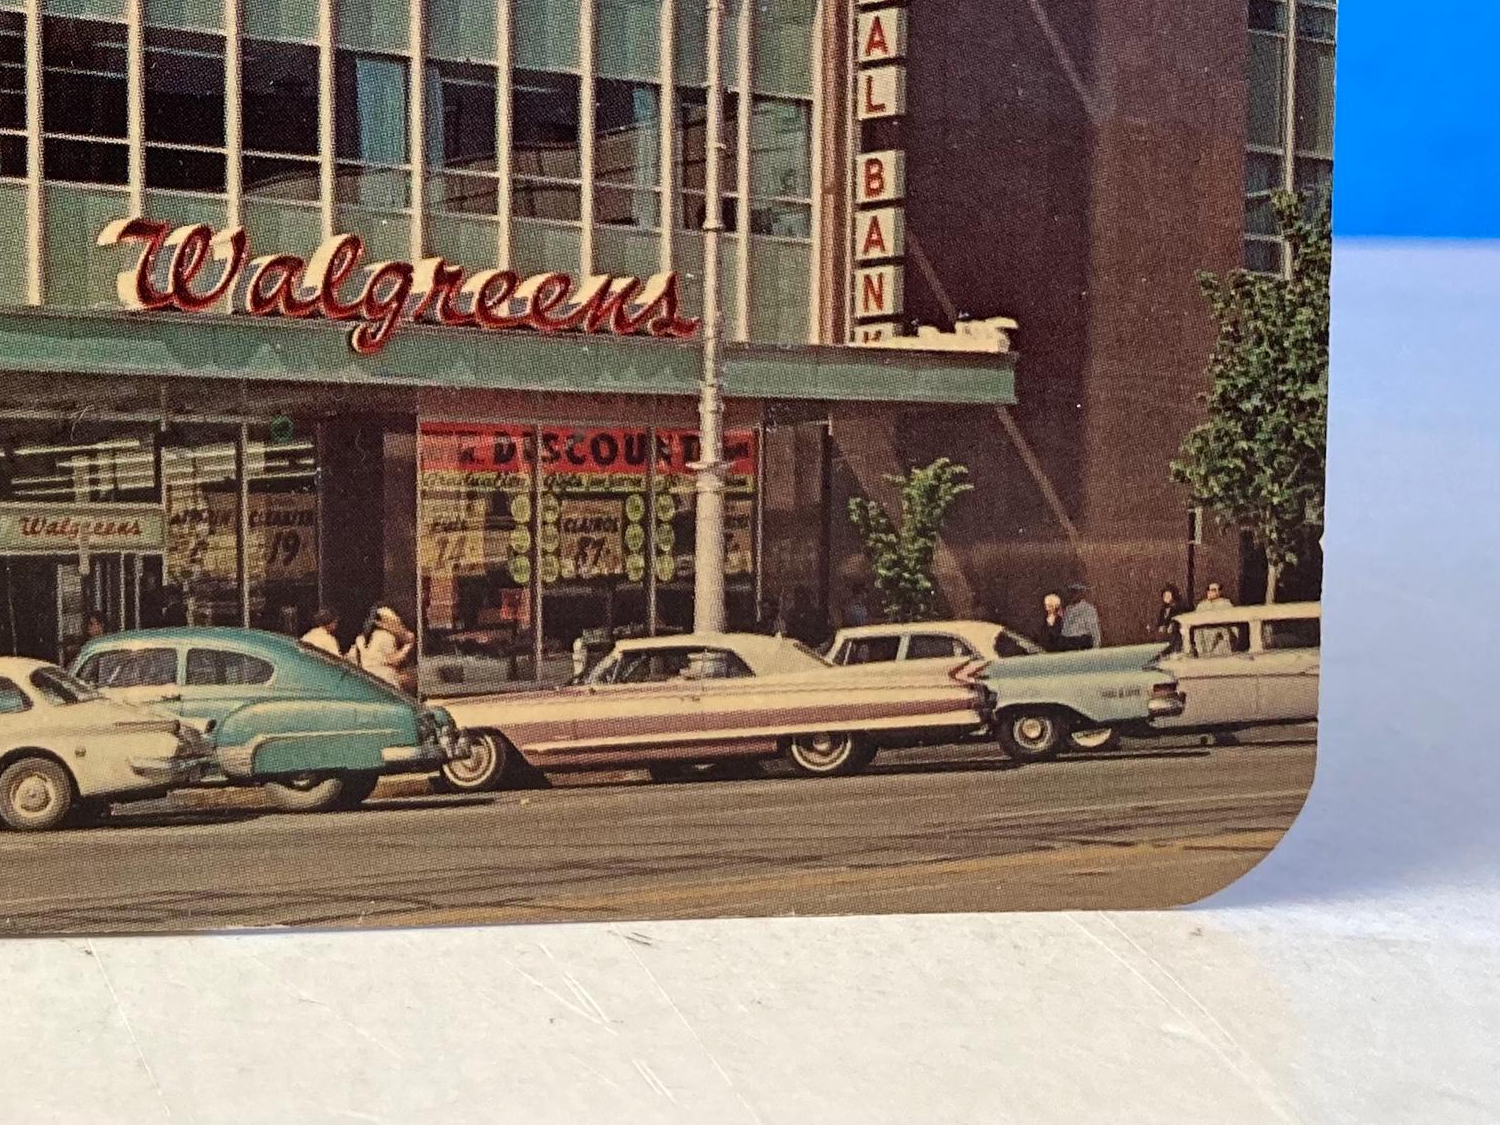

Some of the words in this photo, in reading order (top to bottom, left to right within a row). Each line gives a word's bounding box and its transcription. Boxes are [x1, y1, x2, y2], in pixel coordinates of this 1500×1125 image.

[102, 216, 698, 355] Walgreens
[862, 156, 887, 345] BAN
[18, 515, 143, 540] Walgreens
